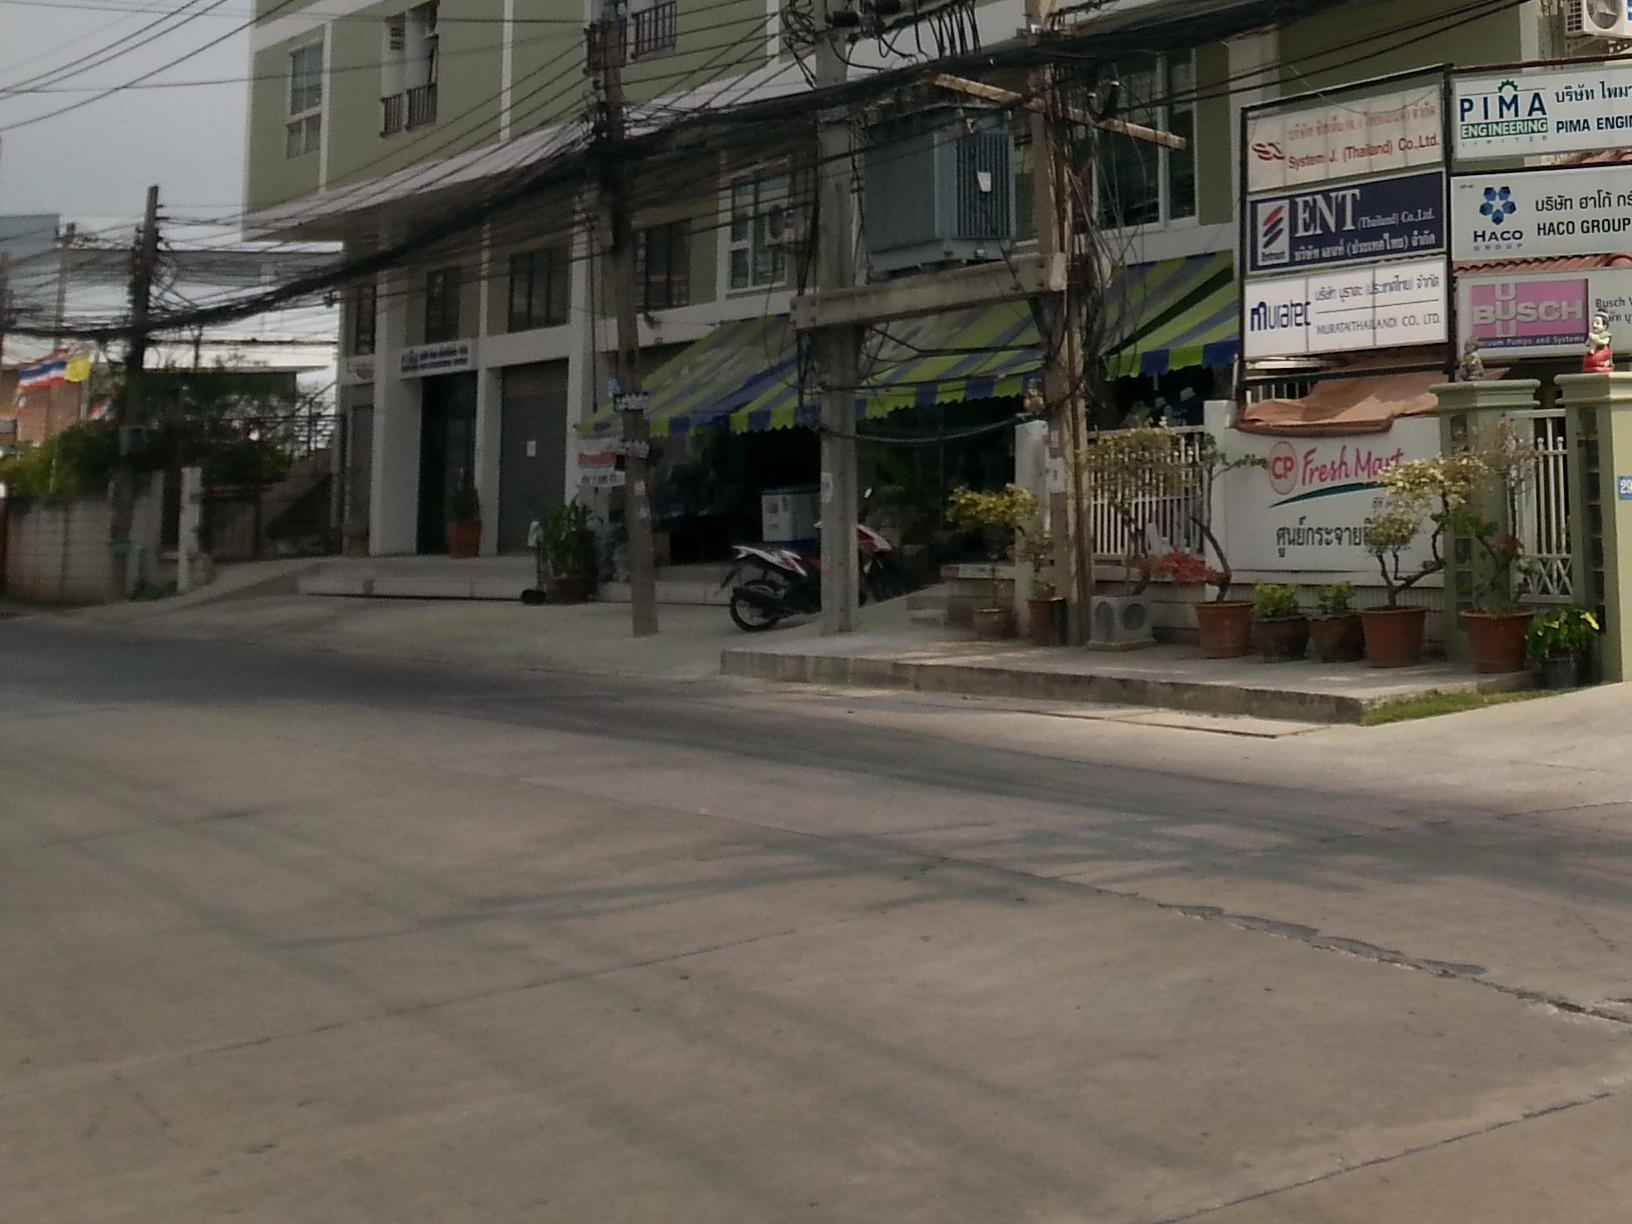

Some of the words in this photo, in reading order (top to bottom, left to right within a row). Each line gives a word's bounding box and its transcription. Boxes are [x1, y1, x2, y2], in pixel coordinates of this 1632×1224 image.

[1555, 84, 1594, 103] บริษัท
[1460, 92, 1548, 122] PIMA
[1461, 119, 1548, 138] ENGINEERING
[1556, 120, 1590, 134] PIMA
[1288, 154, 1325, 171] System
[1343, 140, 1393, 163] (Thailand)
[1398, 134, 1440, 151] Co.,Ltd.
[1535, 194, 1573, 212] บริษัท
[1579, 190, 1612, 210] ฮาโก้
[1294, 189, 1360, 237] ENT
[1358, 212, 1399, 231] (Thailand)
[1473, 230, 1524, 243] HACO
[1537, 222, 1576, 237] HACO
[1581, 217, 1631, 234] GROUP
[1411, 229, 1436, 247] จำกัด
[1472, 299, 1584, 326] BUSCH
[1595, 296, 1626, 309] Busch
[1271, 455, 1294, 479] CP
[1301, 445, 1350, 486] Fresh
